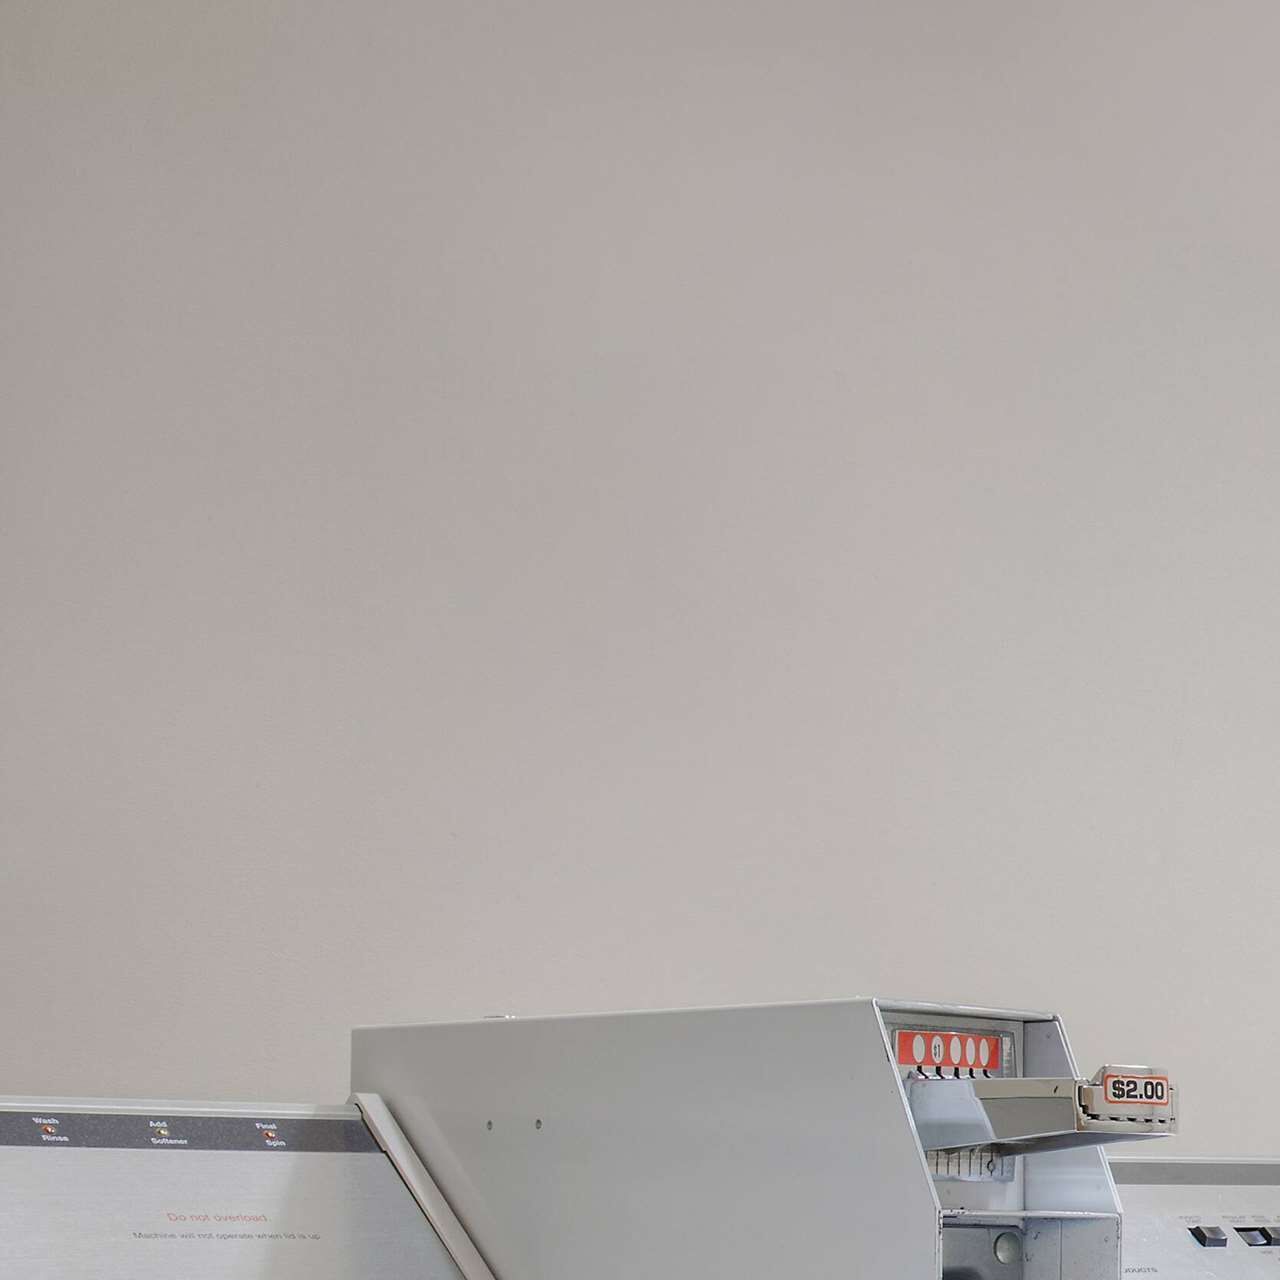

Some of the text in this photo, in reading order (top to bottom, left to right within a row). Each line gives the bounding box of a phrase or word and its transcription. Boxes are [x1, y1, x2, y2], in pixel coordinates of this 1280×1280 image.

[1112, 1079, 1165, 1101] $2.00
[31, 1117, 60, 1125] Wash
[149, 1120, 168, 1128] Add
[255, 1122, 278, 1130] Final
[41, 1134, 70, 1142] Rinse
[150, 1137, 189, 1145] Softener
[265, 1139, 287, 1147] Spin
[166, 1212, 187, 1222] Do
[189, 1213, 211, 1222] not
